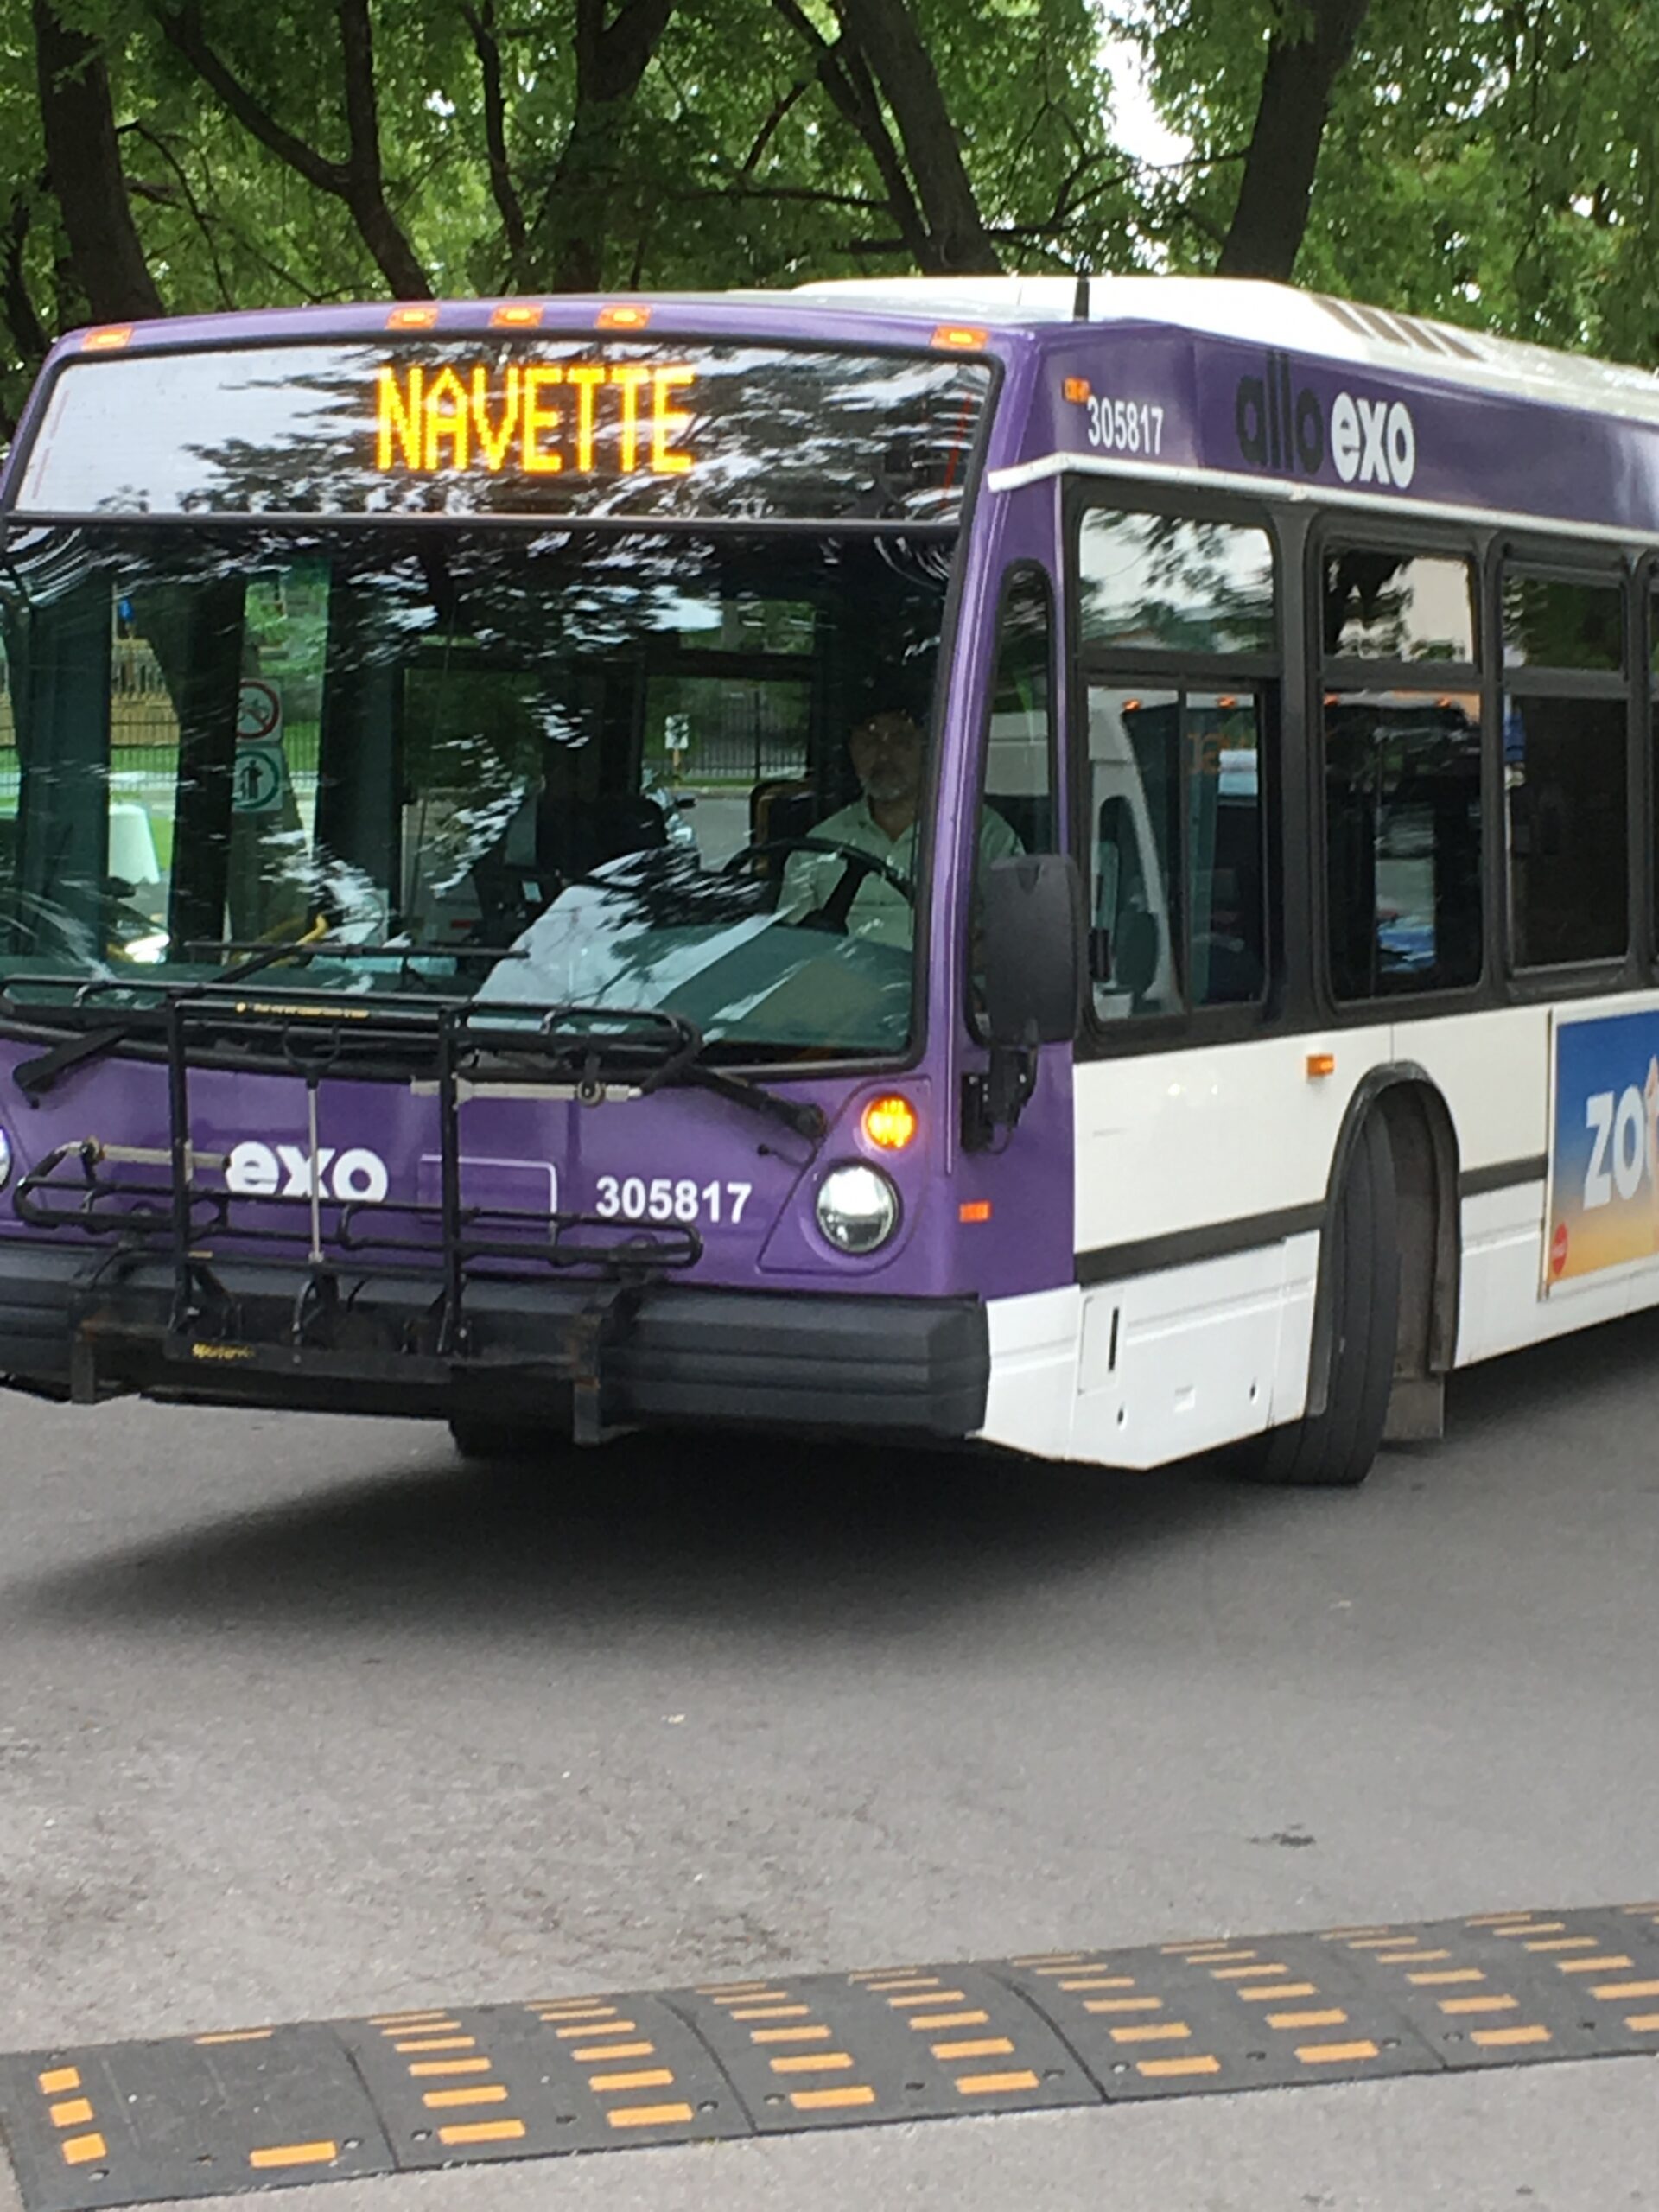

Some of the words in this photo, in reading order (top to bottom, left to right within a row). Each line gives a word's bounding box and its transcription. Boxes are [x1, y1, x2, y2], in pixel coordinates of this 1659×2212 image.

[377, 365, 694, 473] NAVETTE
[1087, 394, 1164, 455] 305817
[1236, 350, 1324, 475] allo
[1331, 391, 1416, 489] exo
[225, 1141, 388, 1202] exo
[1583, 1082, 1659, 1211] ZO
[595, 1175, 753, 1224] 305817
